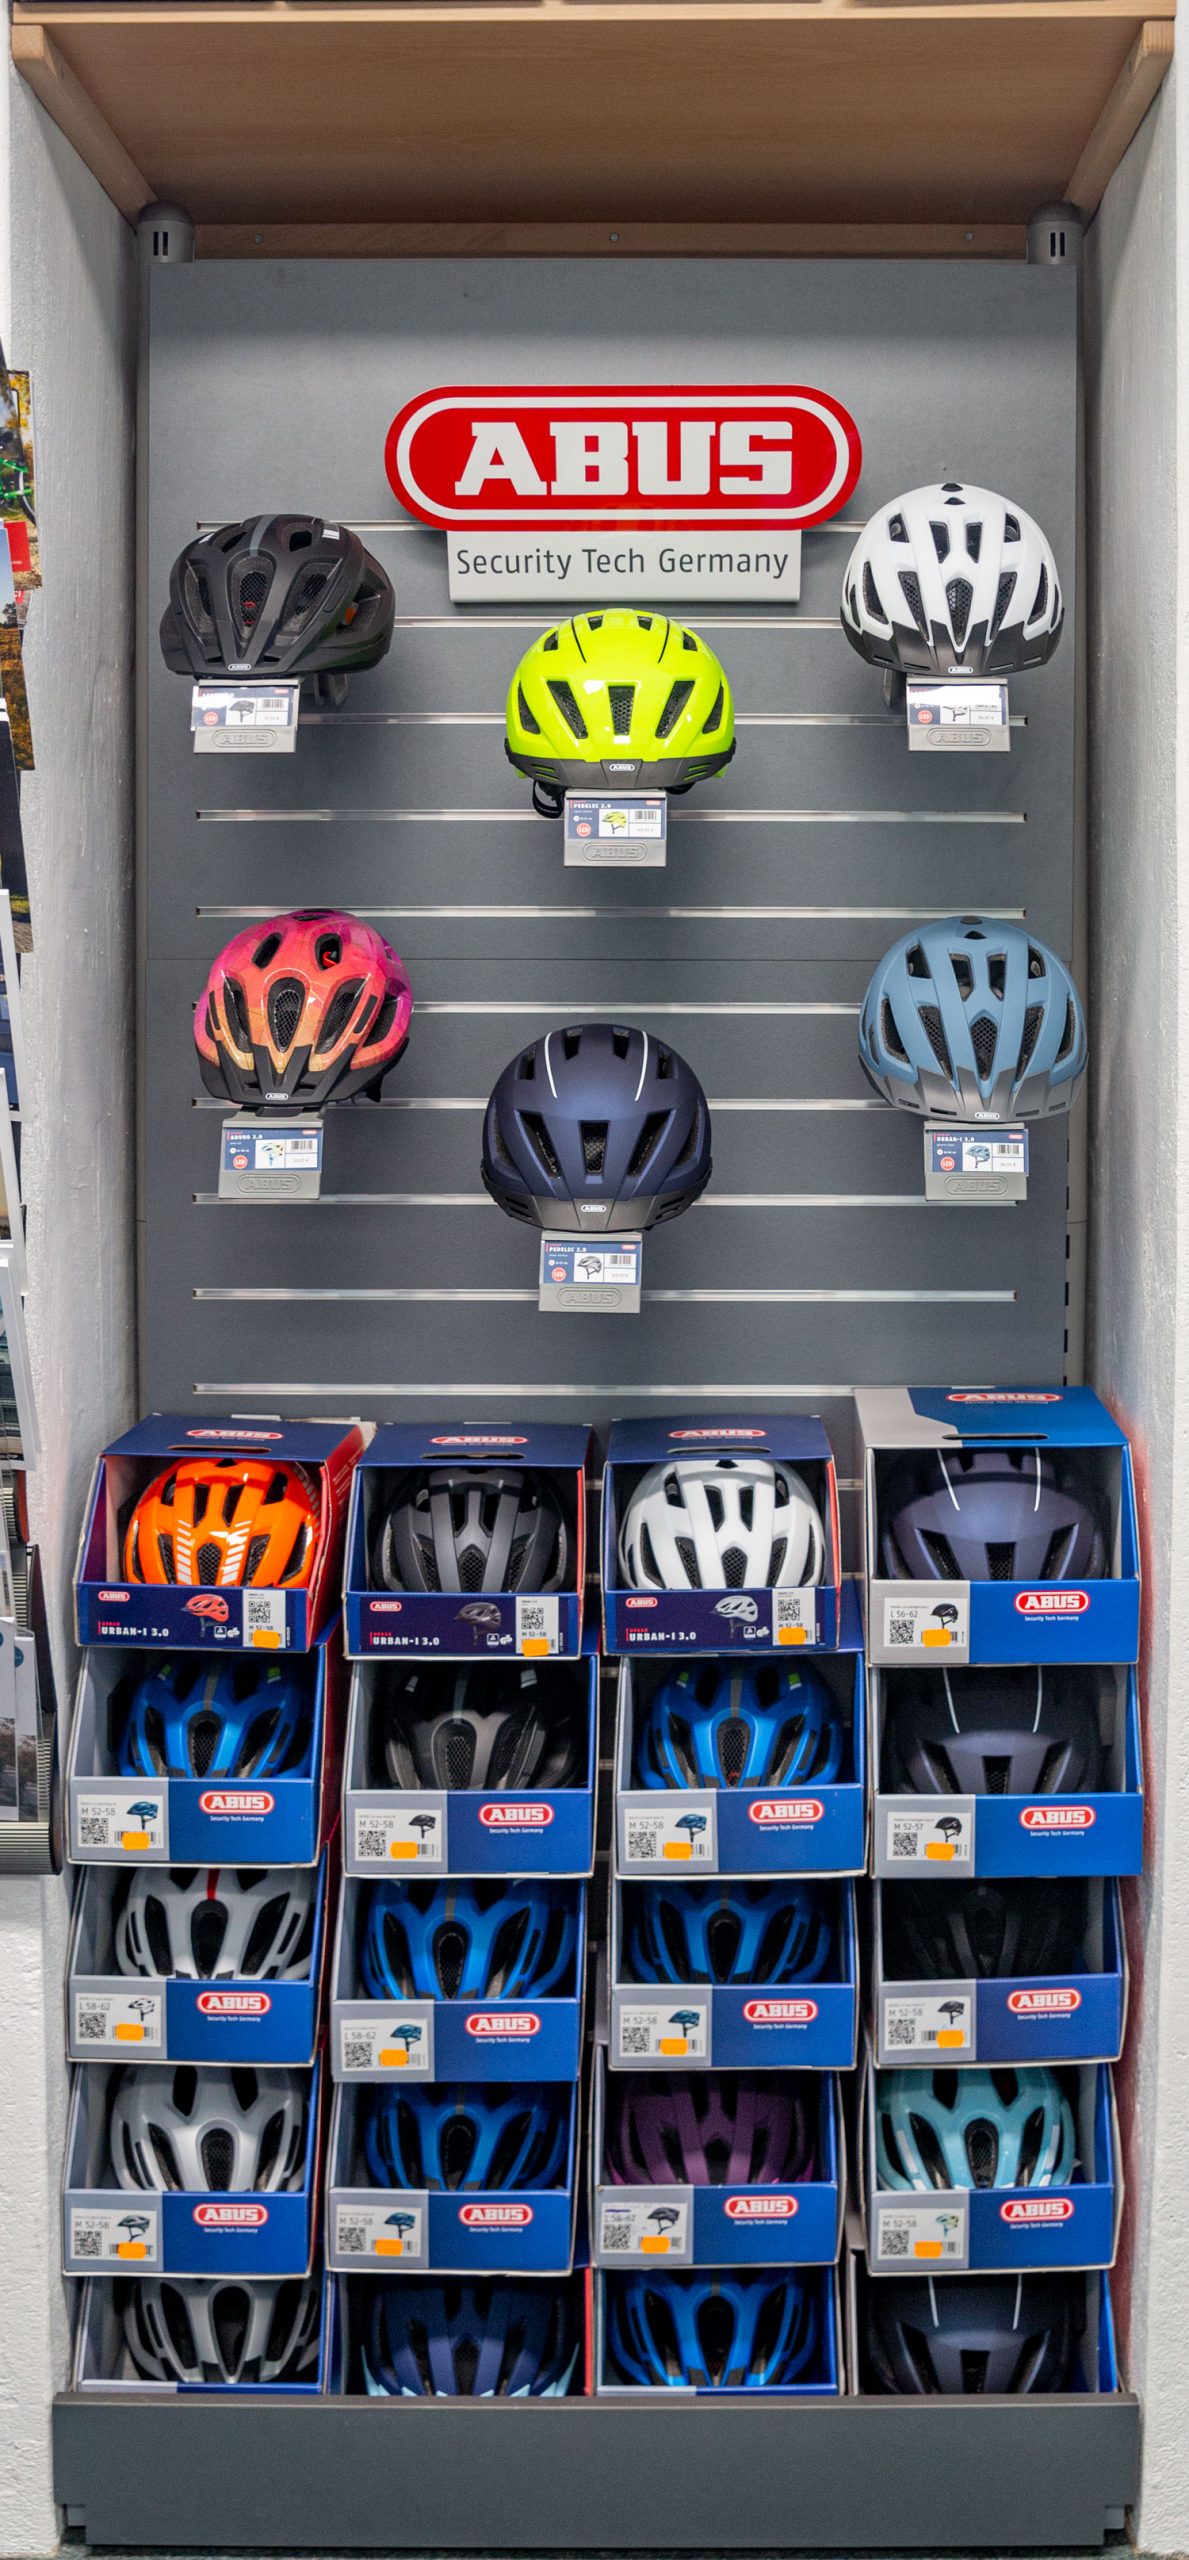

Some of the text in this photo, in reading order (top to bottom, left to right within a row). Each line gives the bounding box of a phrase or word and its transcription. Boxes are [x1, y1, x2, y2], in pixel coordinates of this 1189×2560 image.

[455, 421, 793, 496] ABUS
[457, 547, 789, 580] Security Tech Germany
[1025, 1596, 1080, 1609] ABUS
[101, 1627, 169, 1637] URBAN-I 3.0
[629, 1632, 697, 1641] URBAN-I 3.0
[373, 1637, 440, 1645] URBAN-I 3.0
[210, 1797, 265, 1808] ABUS
[92, 1808, 116, 1816] 52-58
[489, 1809, 544, 1821] ABUS
[759, 1805, 814, 1818] ABUS
[1030, 1811, 1086, 1824] ABUS
[370, 1820, 394, 1829] 52-58
[640, 1821, 664, 1829] 52-58
[207, 1997, 262, 2009] ABUS
[1017, 1993, 1072, 2008] ABUS
[753, 2005, 808, 2017] ABUS
[899, 2008, 923, 2016] 52-58
[476, 2018, 531, 2030] ABUS
[352, 2032, 376, 2040] 58-62
[734, 2200, 789, 2213] ABUS
[1010, 2203, 1065, 2217] ABUS
[203, 2208, 259, 2221] ABUS
[469, 2208, 524, 2220] ABUS
